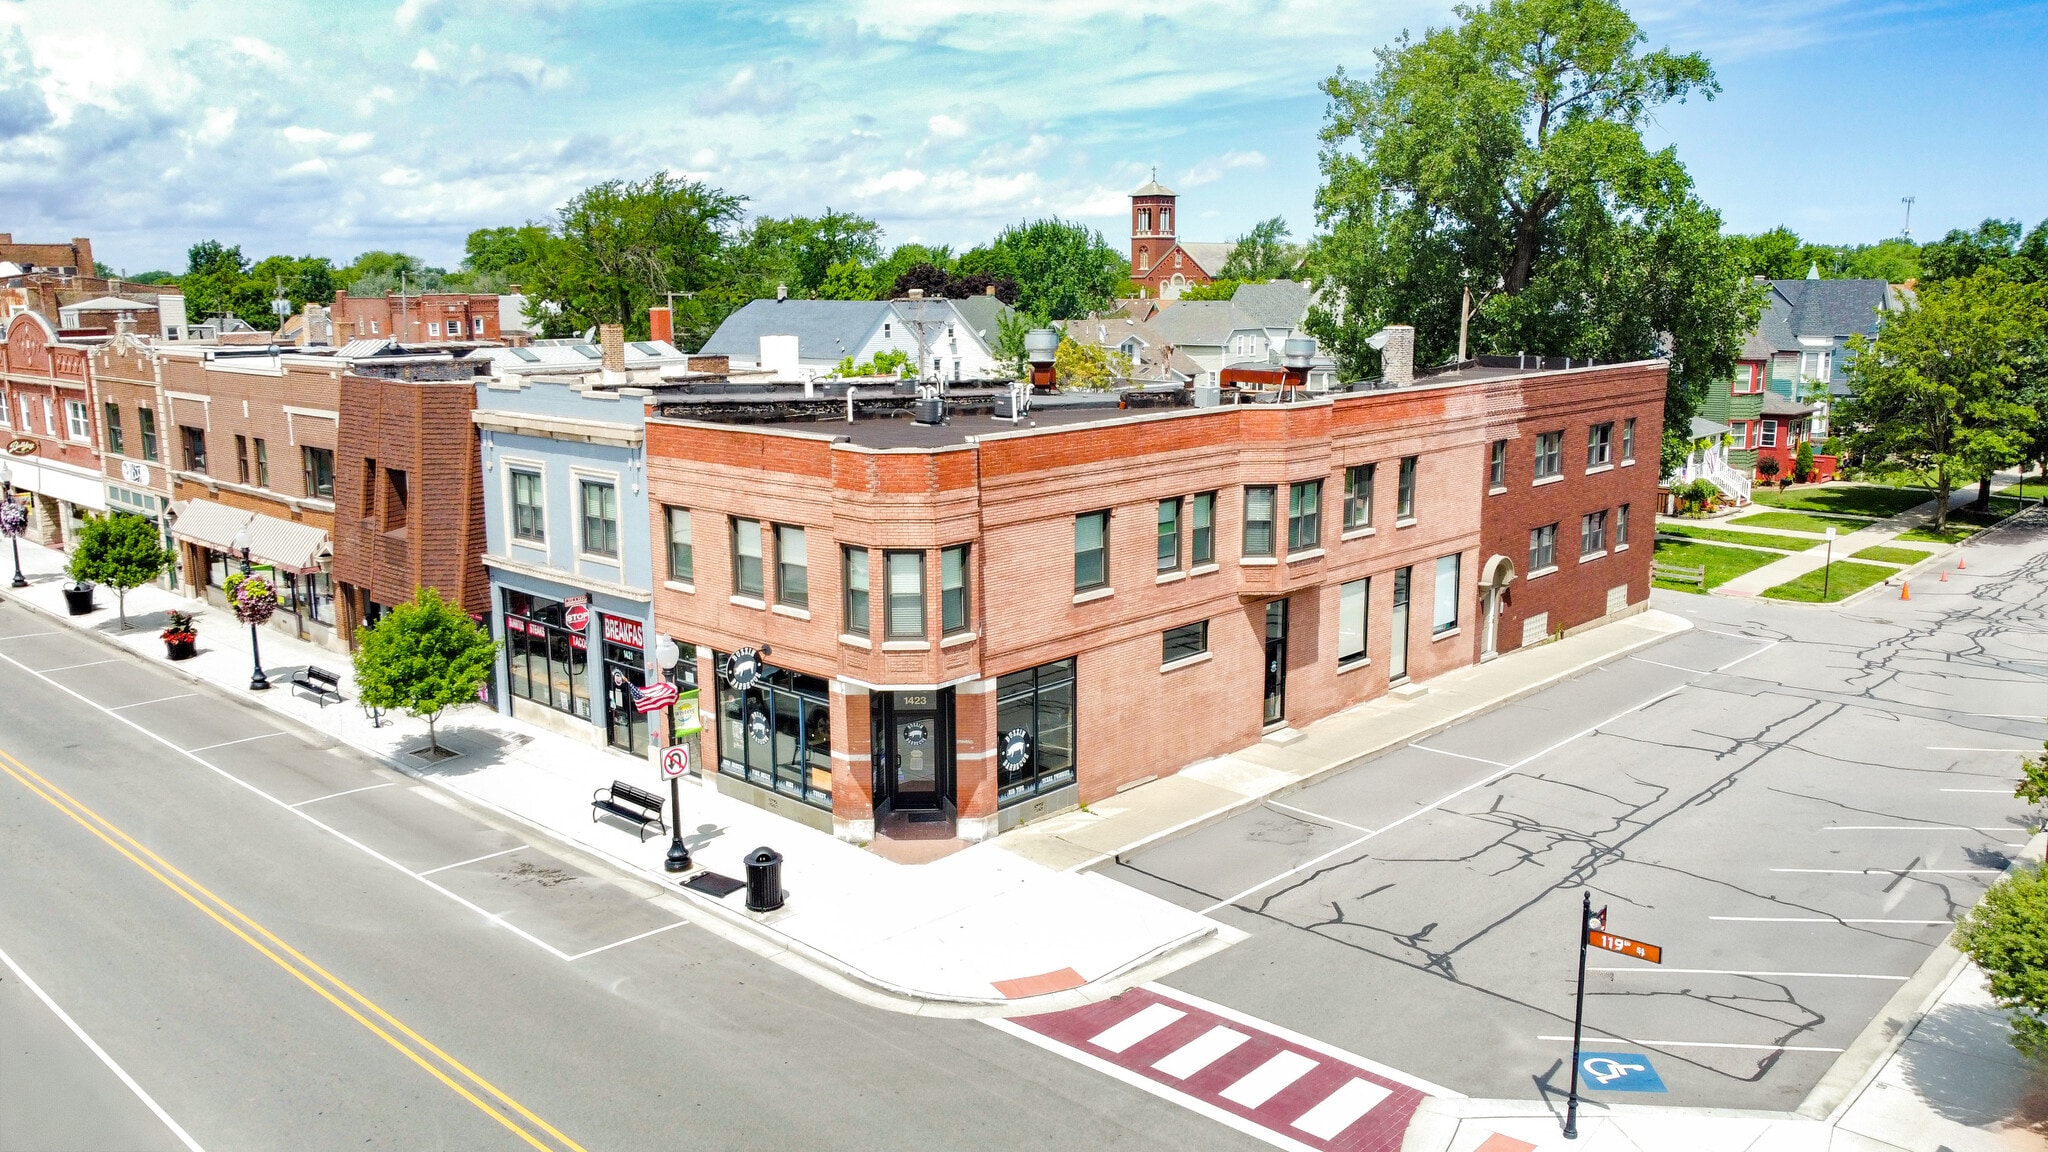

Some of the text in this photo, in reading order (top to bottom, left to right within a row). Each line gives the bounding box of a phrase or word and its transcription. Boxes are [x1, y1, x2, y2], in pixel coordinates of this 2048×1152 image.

[566, 612, 589, 622] STOP
[529, 623, 546, 638] STEAKS
[604, 617, 644, 647] BREAKFAS
[904, 696, 927, 705] 1423
